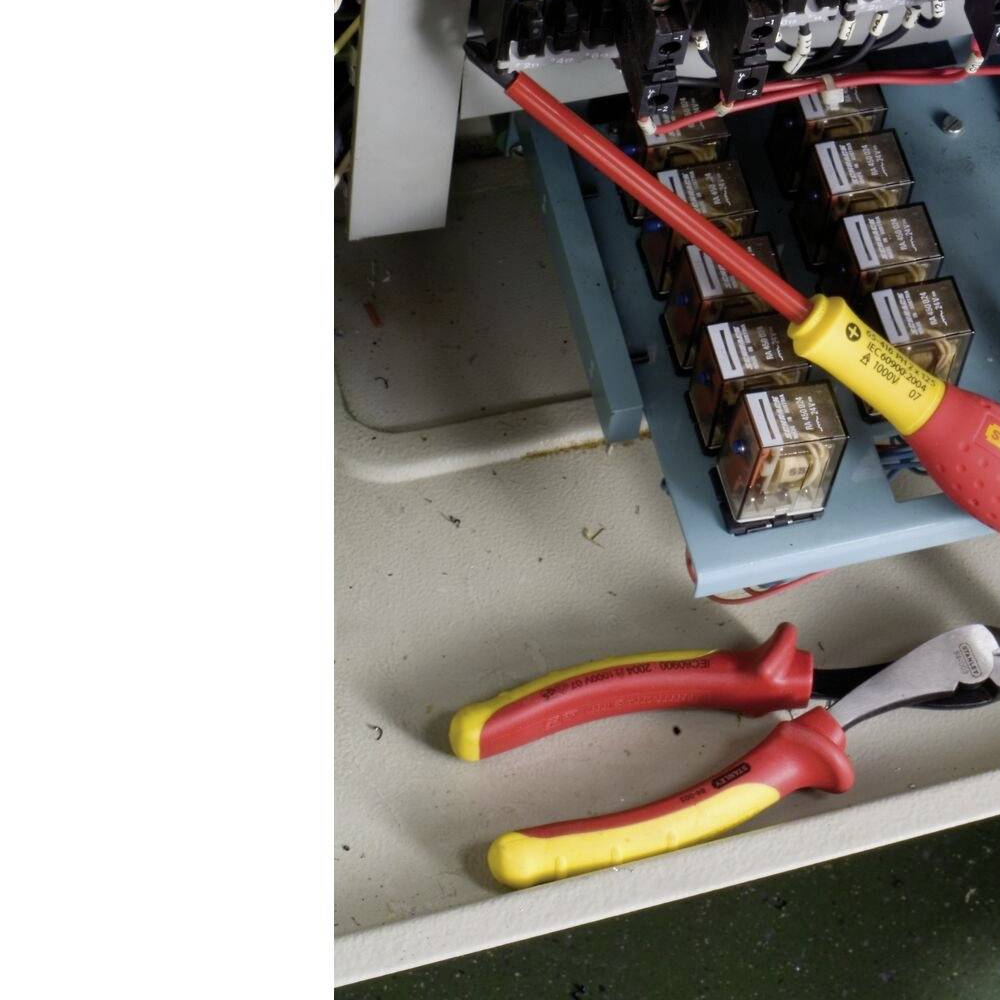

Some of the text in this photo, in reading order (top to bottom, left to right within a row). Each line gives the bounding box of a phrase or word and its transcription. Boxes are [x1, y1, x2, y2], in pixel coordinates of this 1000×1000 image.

[867, 342, 880, 357] IEC
[873, 360, 922, 401] 1000V 07
[714, 764, 749, 787] STANLEY
